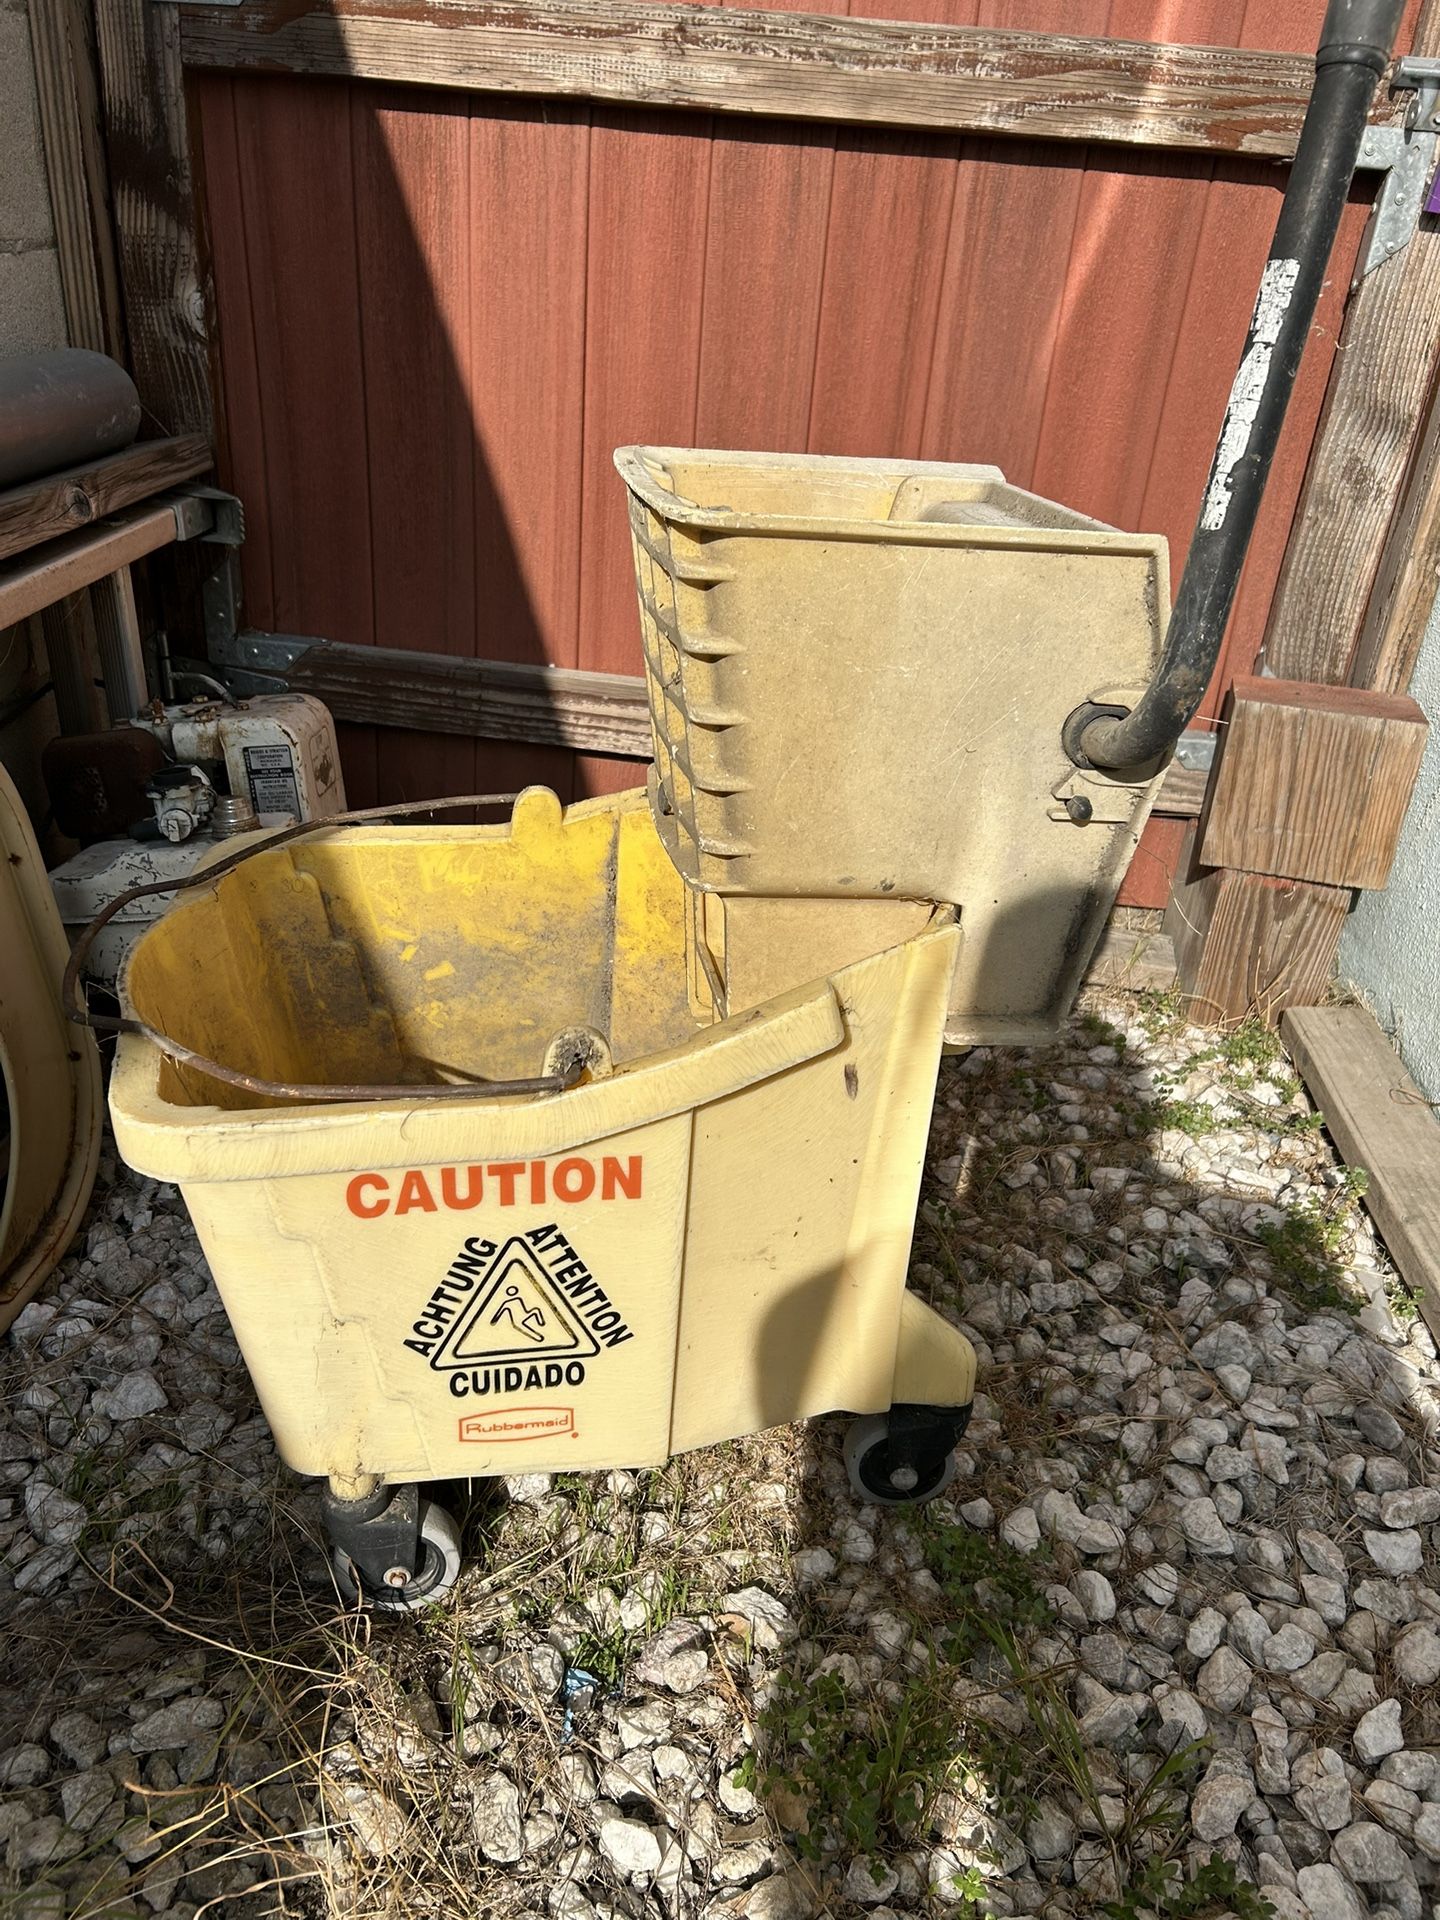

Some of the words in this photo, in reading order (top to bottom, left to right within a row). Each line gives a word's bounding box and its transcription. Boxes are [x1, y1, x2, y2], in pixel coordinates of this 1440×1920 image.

[346, 1155, 642, 1219] CAUTION
[403, 1236, 499, 1358] ACHTUNG
[525, 1223, 634, 1348] ATTENTION
[449, 1361, 586, 1398] CUIDADO
[466, 1415, 569, 1435] Rubbermaid
